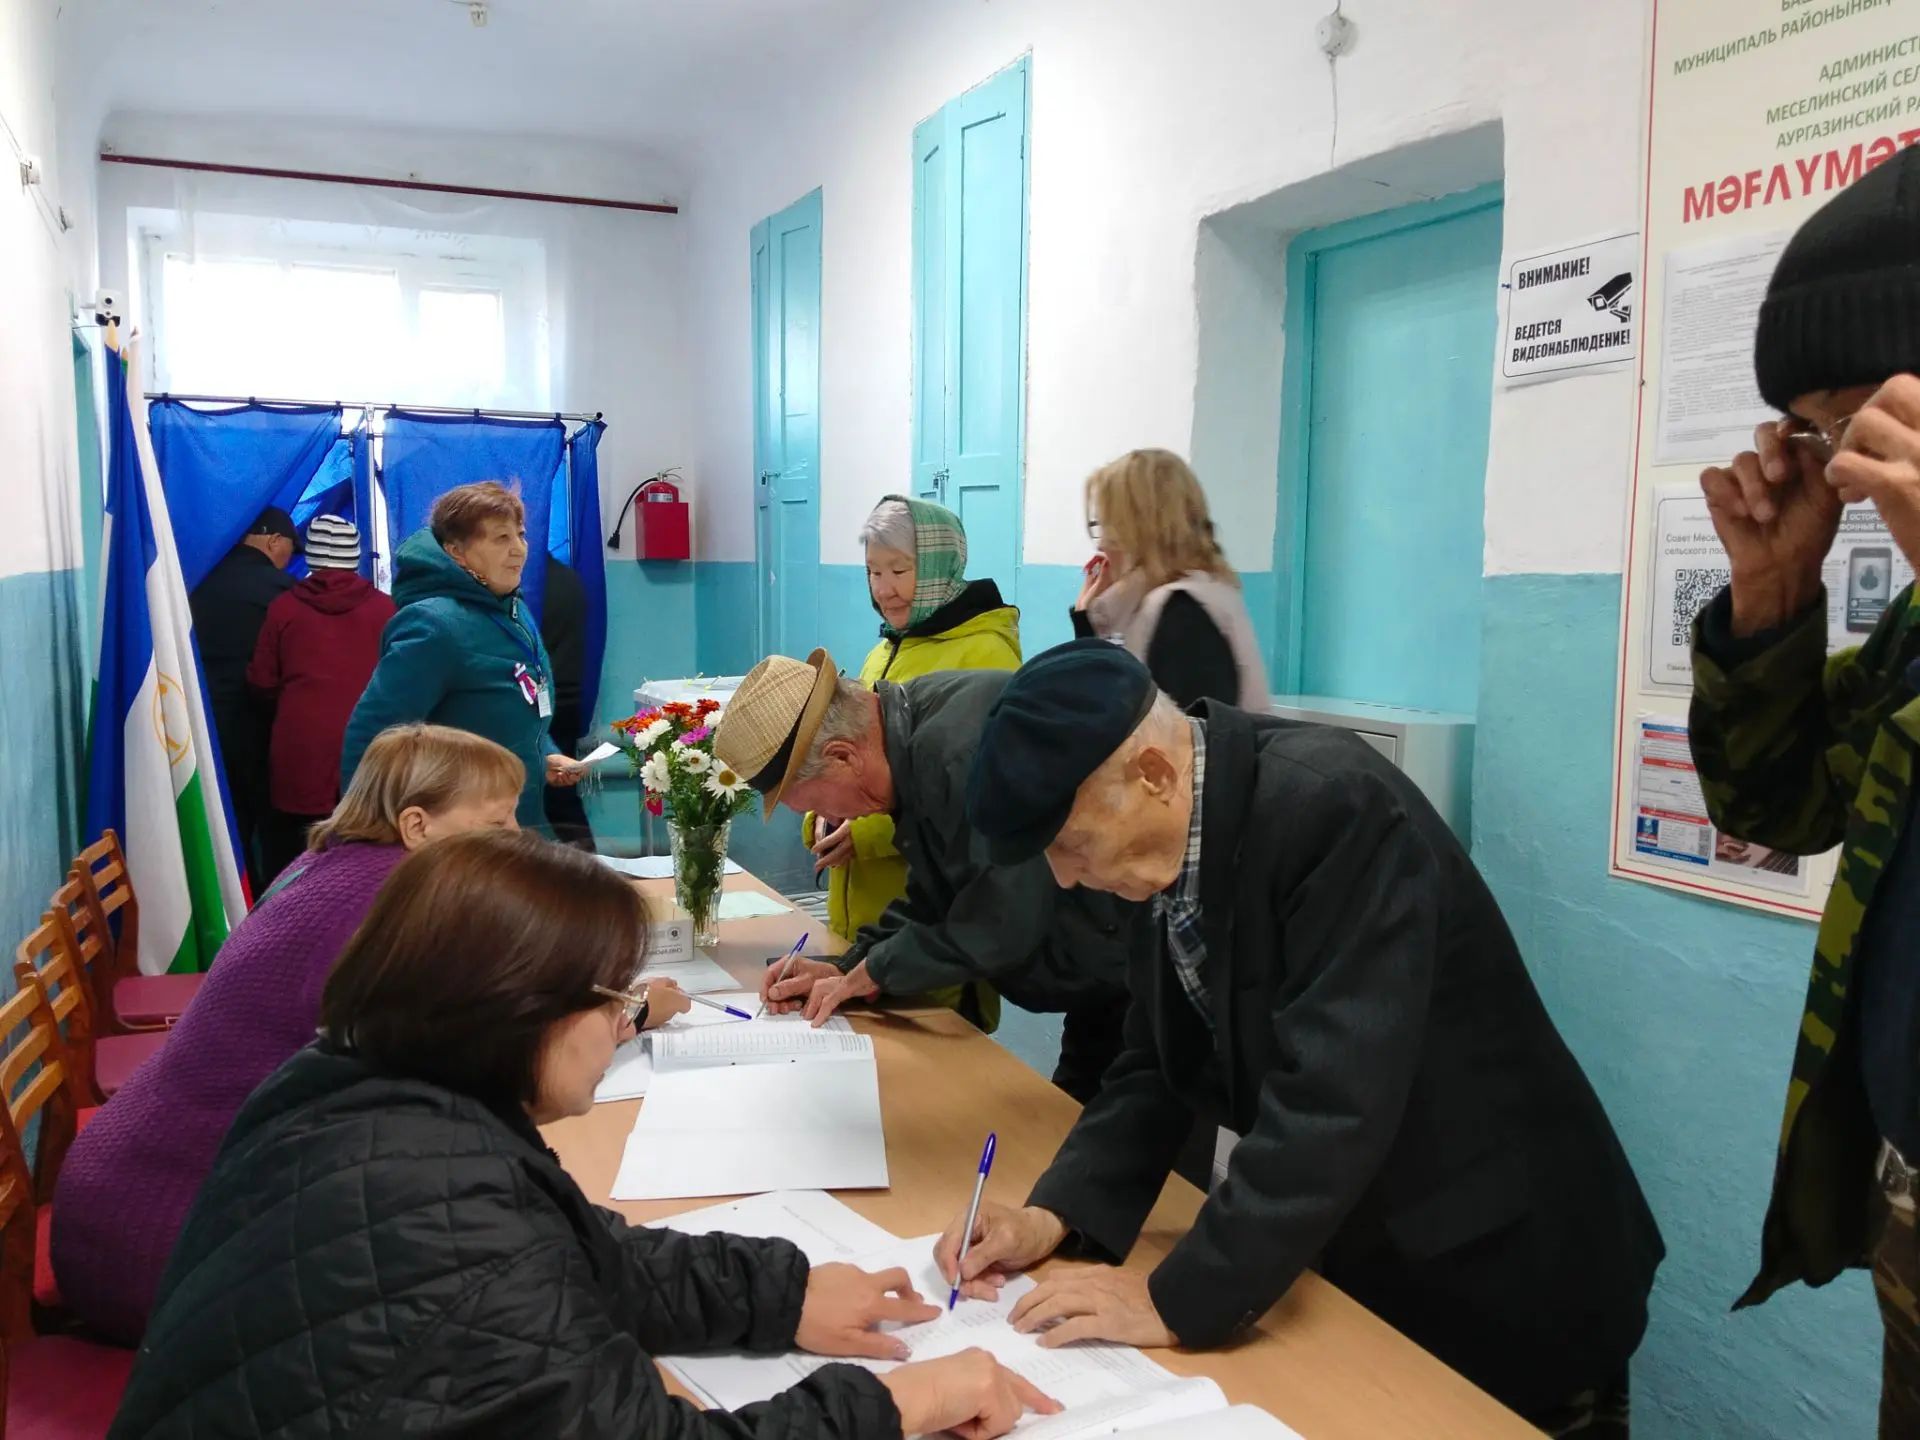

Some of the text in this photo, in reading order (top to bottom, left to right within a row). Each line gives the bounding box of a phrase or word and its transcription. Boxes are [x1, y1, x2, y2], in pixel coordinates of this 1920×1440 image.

[1674, 29, 1777, 75] МУНИЦИПАЛЬ
[1819, 35, 1920, 83] АДМИНИСТ
[1766, 70, 1888, 124] МЕСЕЛИНСКИЙ
[1776, 96, 1901, 149] АУРГАЗИНСКИЙ
[1518, 256, 1590, 290] ВНИМАНИЕ!
[1512, 329, 1630, 363] ВИДЕОНАБЛЮДЕНИЕ!
[1514, 319, 1562, 341] ВЕДЕТСЯ
